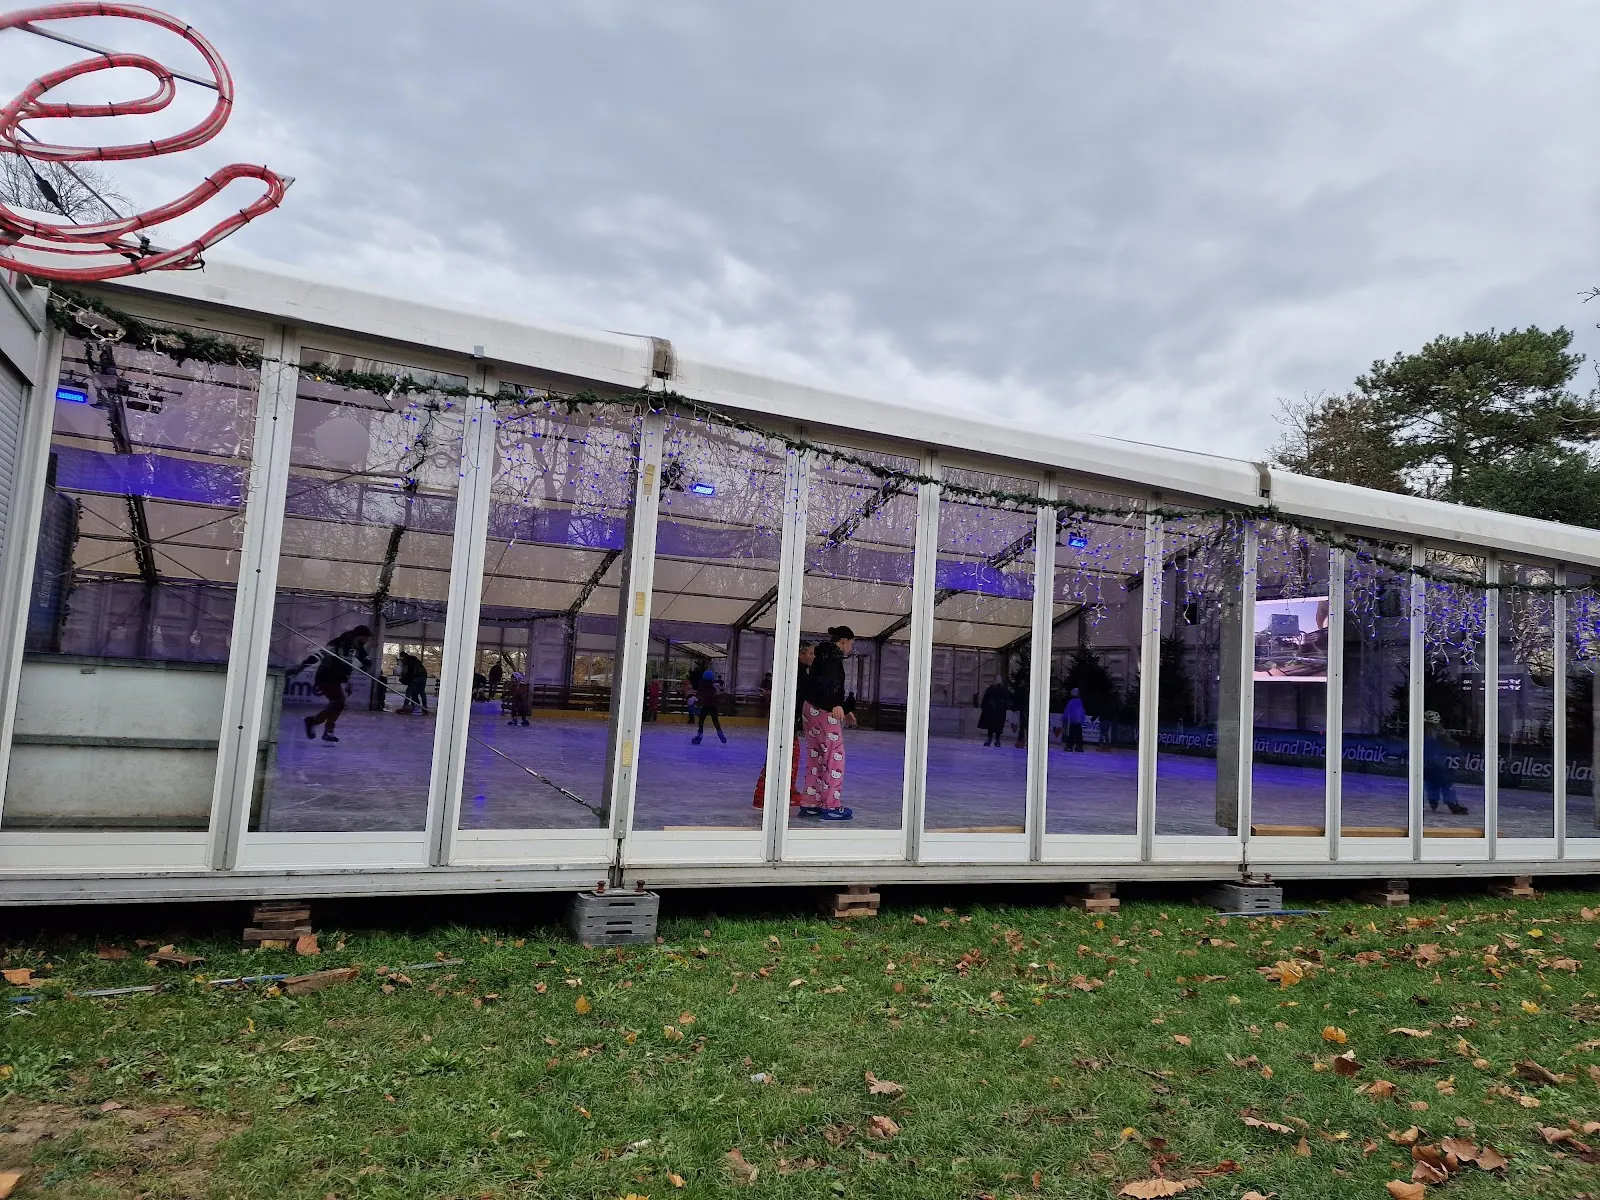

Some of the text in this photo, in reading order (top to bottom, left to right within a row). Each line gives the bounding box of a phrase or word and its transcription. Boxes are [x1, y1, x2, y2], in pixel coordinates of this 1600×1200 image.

[1274, 739, 1300, 755] und
[1302, 741, 1387, 763] Phovoltaik
[1464, 753, 1506, 774] läut
[1510, 757, 1552, 778] alles
